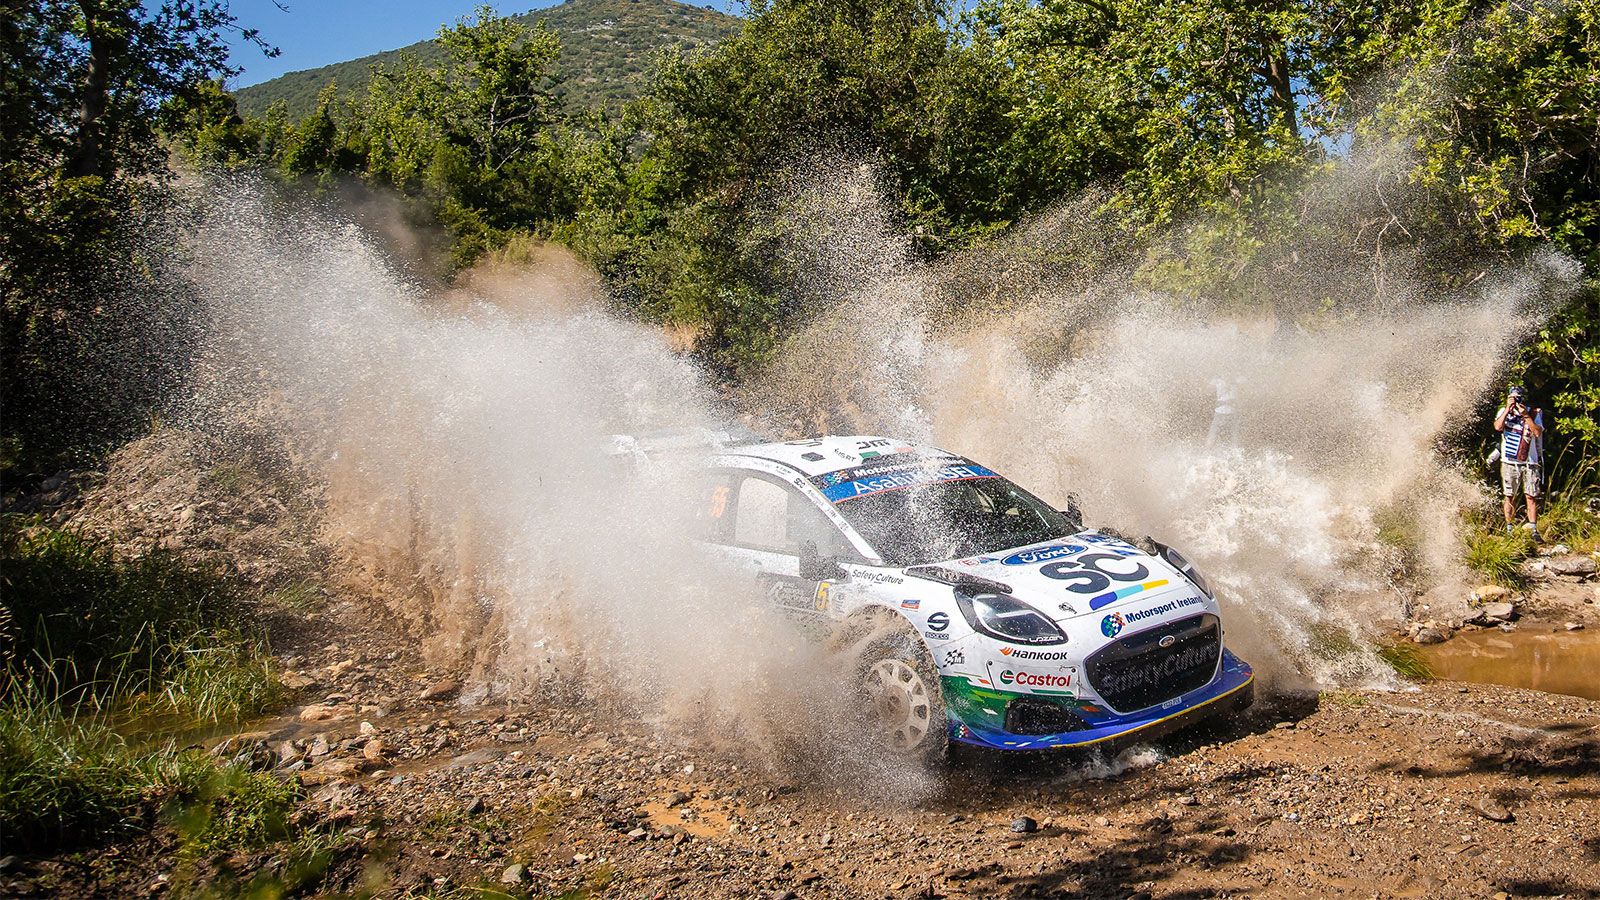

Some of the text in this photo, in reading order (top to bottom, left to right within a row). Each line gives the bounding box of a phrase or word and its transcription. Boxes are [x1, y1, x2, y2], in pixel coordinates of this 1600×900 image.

[1020, 546, 1076, 563] Ford
[851, 569, 904, 585] SafetyCulture
[1040, 553, 1149, 594] SC
[1124, 596, 1204, 624] Motorsport Ireland
[1015, 671, 1071, 687] Castrol
